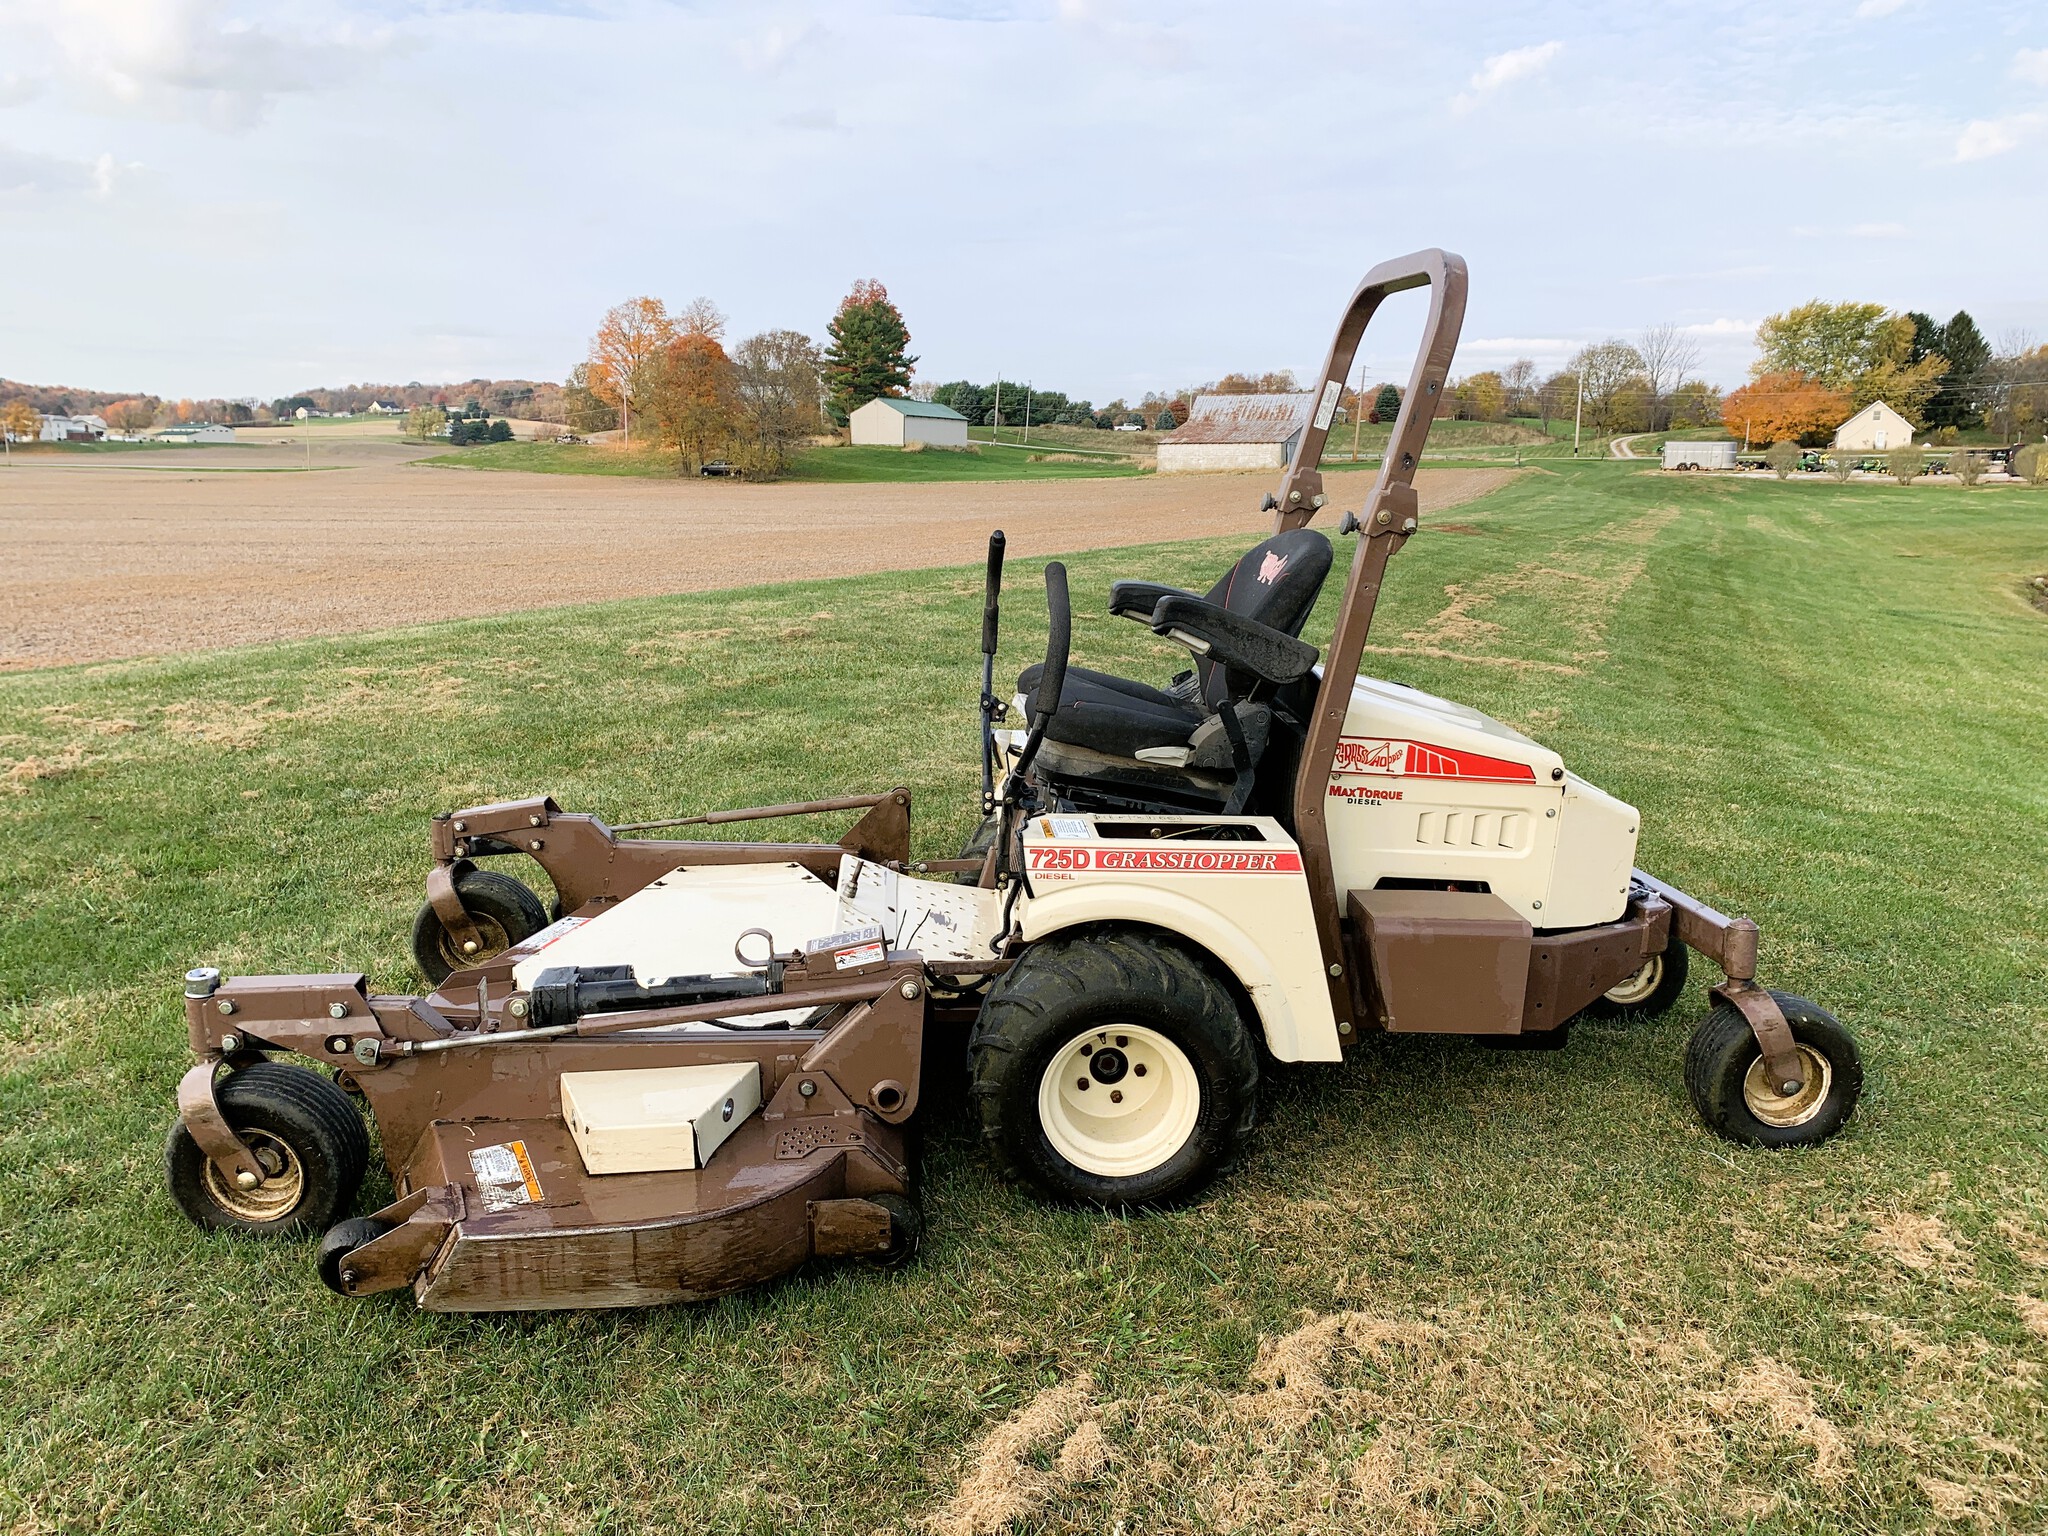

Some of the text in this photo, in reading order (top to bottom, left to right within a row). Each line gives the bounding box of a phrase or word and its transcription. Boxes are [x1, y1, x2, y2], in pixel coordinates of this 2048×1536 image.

[1347, 798, 1382, 806] DIESEL
[1029, 849, 1277, 870] 725D GRASSHOPPER
[1034, 872, 1075, 880] DIESEL
